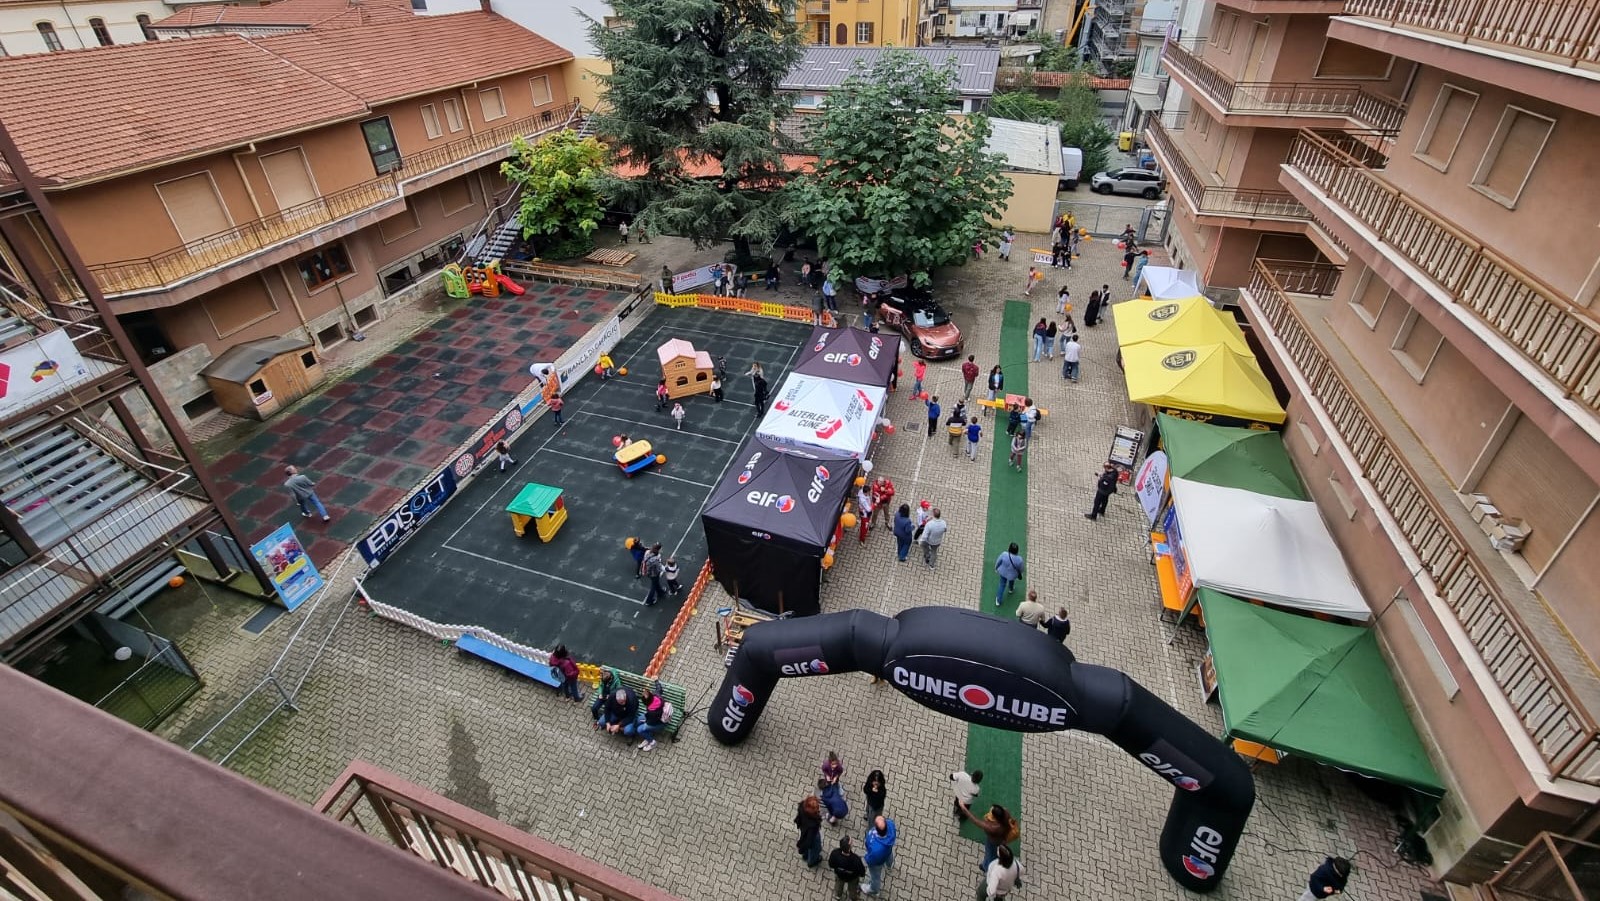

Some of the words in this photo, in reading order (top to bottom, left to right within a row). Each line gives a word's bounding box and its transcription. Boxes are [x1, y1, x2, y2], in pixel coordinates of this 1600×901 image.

[823, 353, 848, 363] elf
[788, 409, 829, 423] ALTERLEG
[797, 419, 822, 430] CUNE
[746, 490, 778, 507] elf
[807, 475, 824, 503] elf
[366, 474, 445, 555] EDISOFT
[781, 661, 808, 675] elf
[722, 698, 745, 733] elf
[1140, 752, 1183, 780] elf
[1190, 825, 1223, 863] elf
